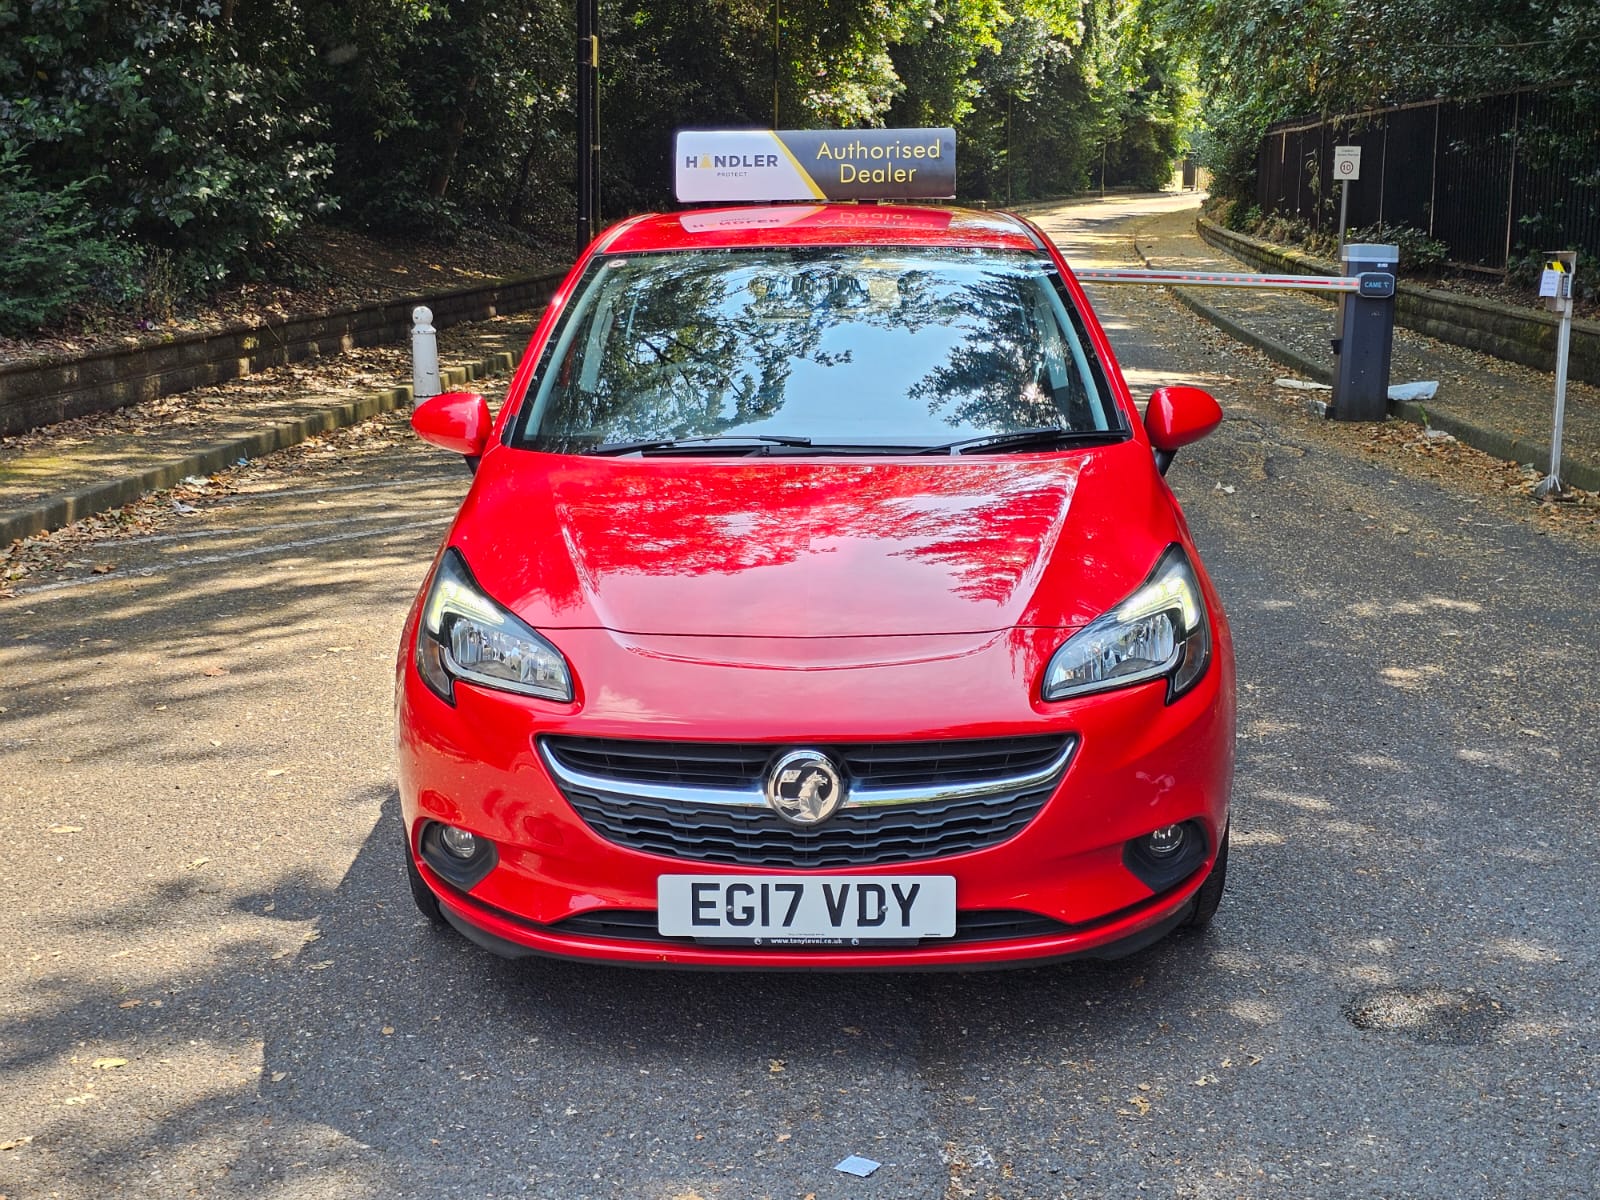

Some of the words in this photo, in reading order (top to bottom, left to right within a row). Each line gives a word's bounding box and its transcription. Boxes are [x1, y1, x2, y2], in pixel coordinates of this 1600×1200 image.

[816, 138, 940, 160] Authorised
[840, 161, 917, 183] Dealer
[691, 882, 805, 927] EG17
[821, 883, 921, 927] VDY
